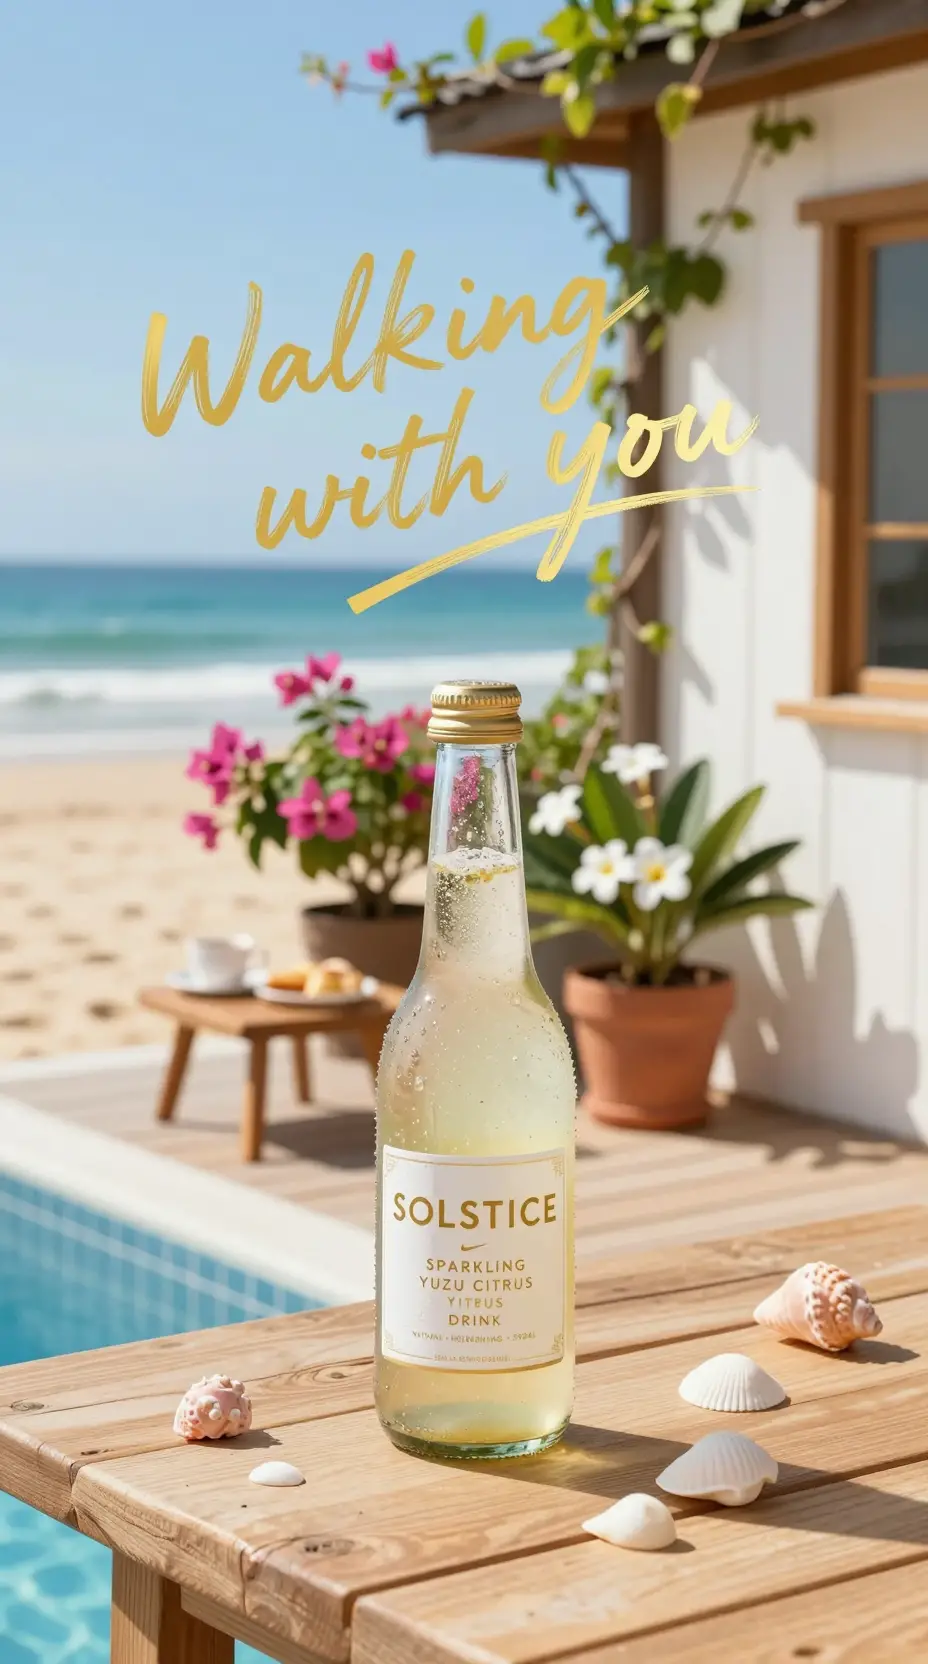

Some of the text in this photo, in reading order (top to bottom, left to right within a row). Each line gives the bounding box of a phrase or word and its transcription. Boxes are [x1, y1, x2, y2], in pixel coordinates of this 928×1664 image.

[393, 1192, 557, 1229] SOLSTICE
[426, 1258, 526, 1273] SPARKLING
[419, 1276, 534, 1292] YUZU CITRUS
[448, 1314, 502, 1327] DRINK
